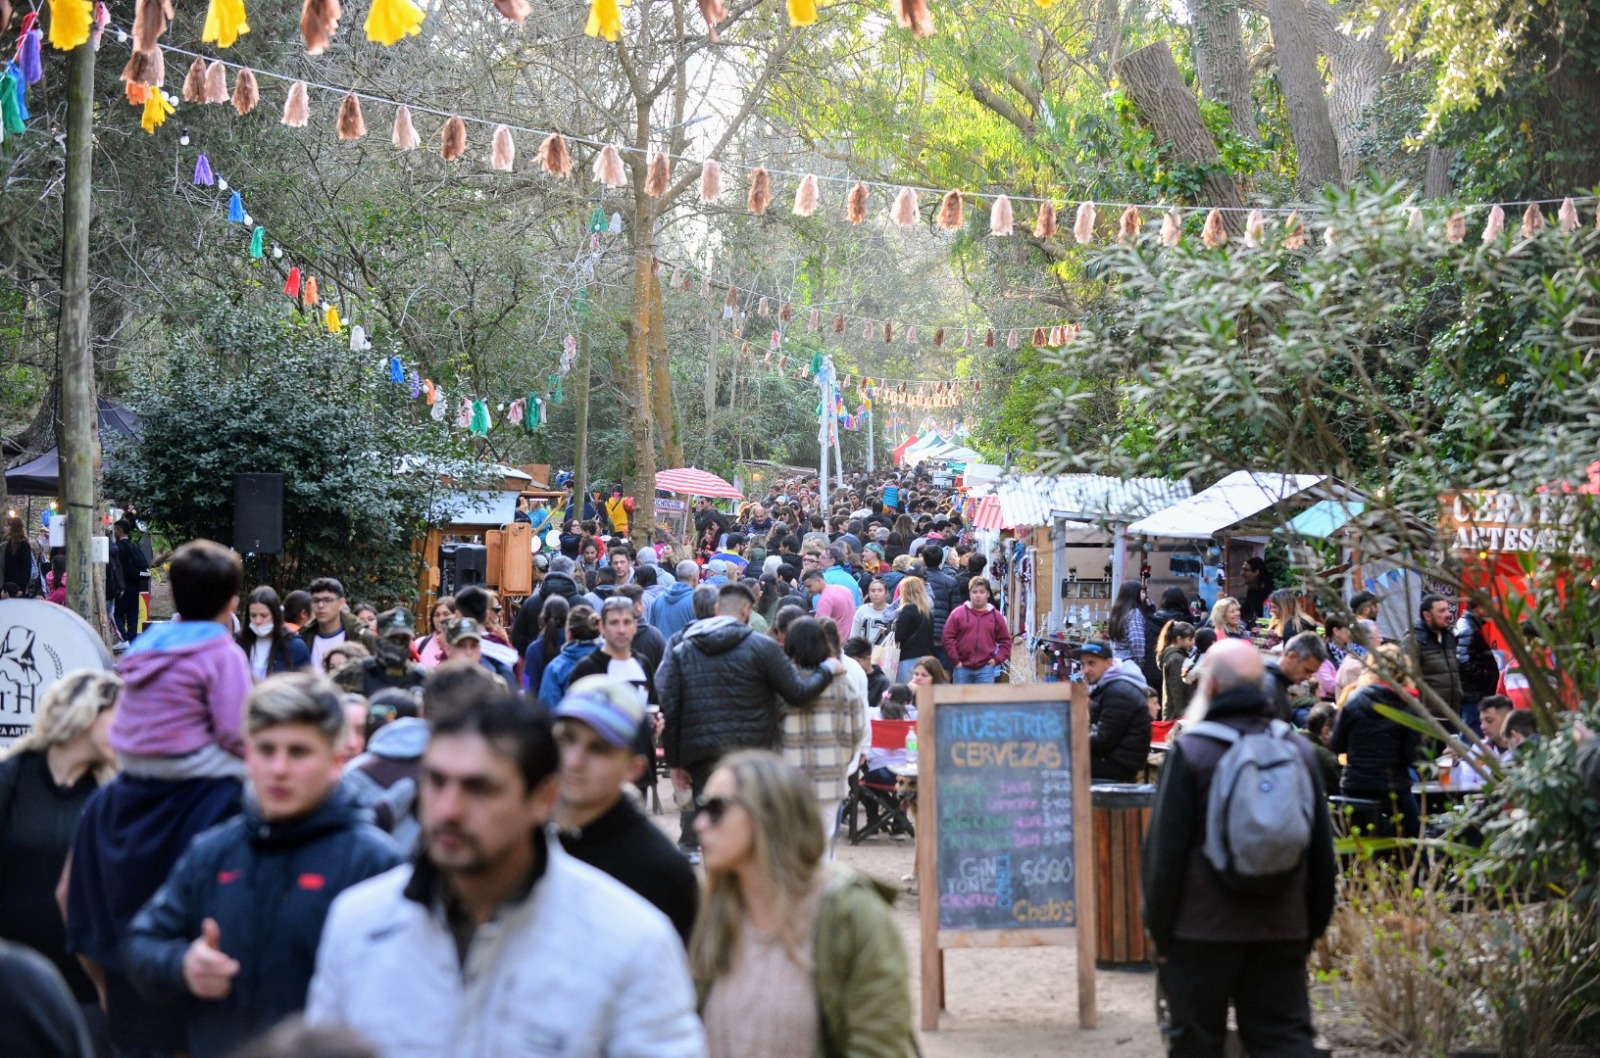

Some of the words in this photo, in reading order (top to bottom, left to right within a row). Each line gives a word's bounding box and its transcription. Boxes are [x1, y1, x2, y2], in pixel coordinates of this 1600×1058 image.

[1453, 492, 1579, 525] CERVEZ
[952, 711, 1062, 738] NUESTRAS
[951, 741, 1062, 768] CERVEZAS
[1020, 857, 1073, 887] $600
